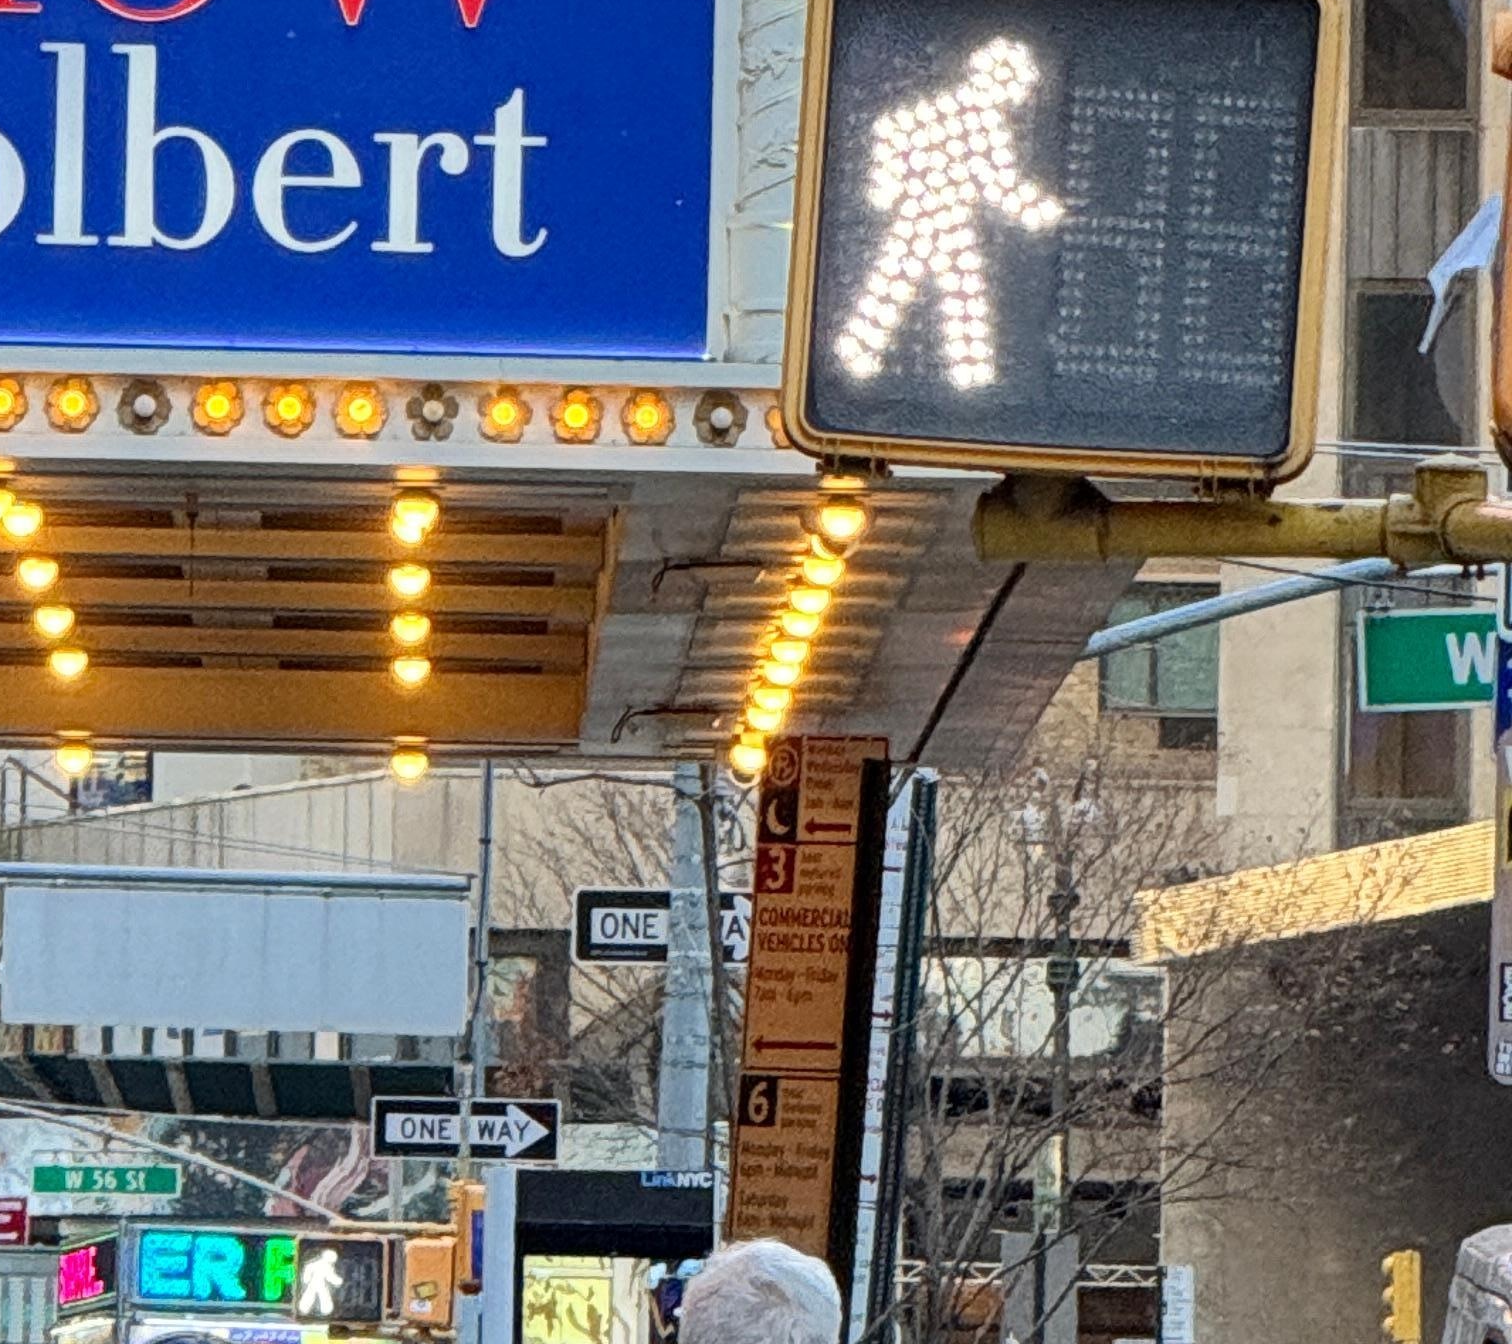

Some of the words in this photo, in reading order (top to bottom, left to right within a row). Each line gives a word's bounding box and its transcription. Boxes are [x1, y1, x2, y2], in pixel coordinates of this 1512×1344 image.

[1445, 631, 1497, 685] W
[765, 845, 787, 890] 3
[600, 912, 659, 940] ONE
[758, 907, 850, 928] COMMERCIAL
[757, 933, 824, 953] VEHICLES
[748, 1081, 769, 1123] 6
[400, 1117, 451, 1140] ONE
[477, 1119, 530, 1142] WAY
[65, 1170, 83, 1189] W
[92, 1170, 117, 1189] 56
[125, 1170, 146, 1191] St
[640, 1170, 713, 1188] LinkNYC
[141, 1232, 246, 1301] ER
